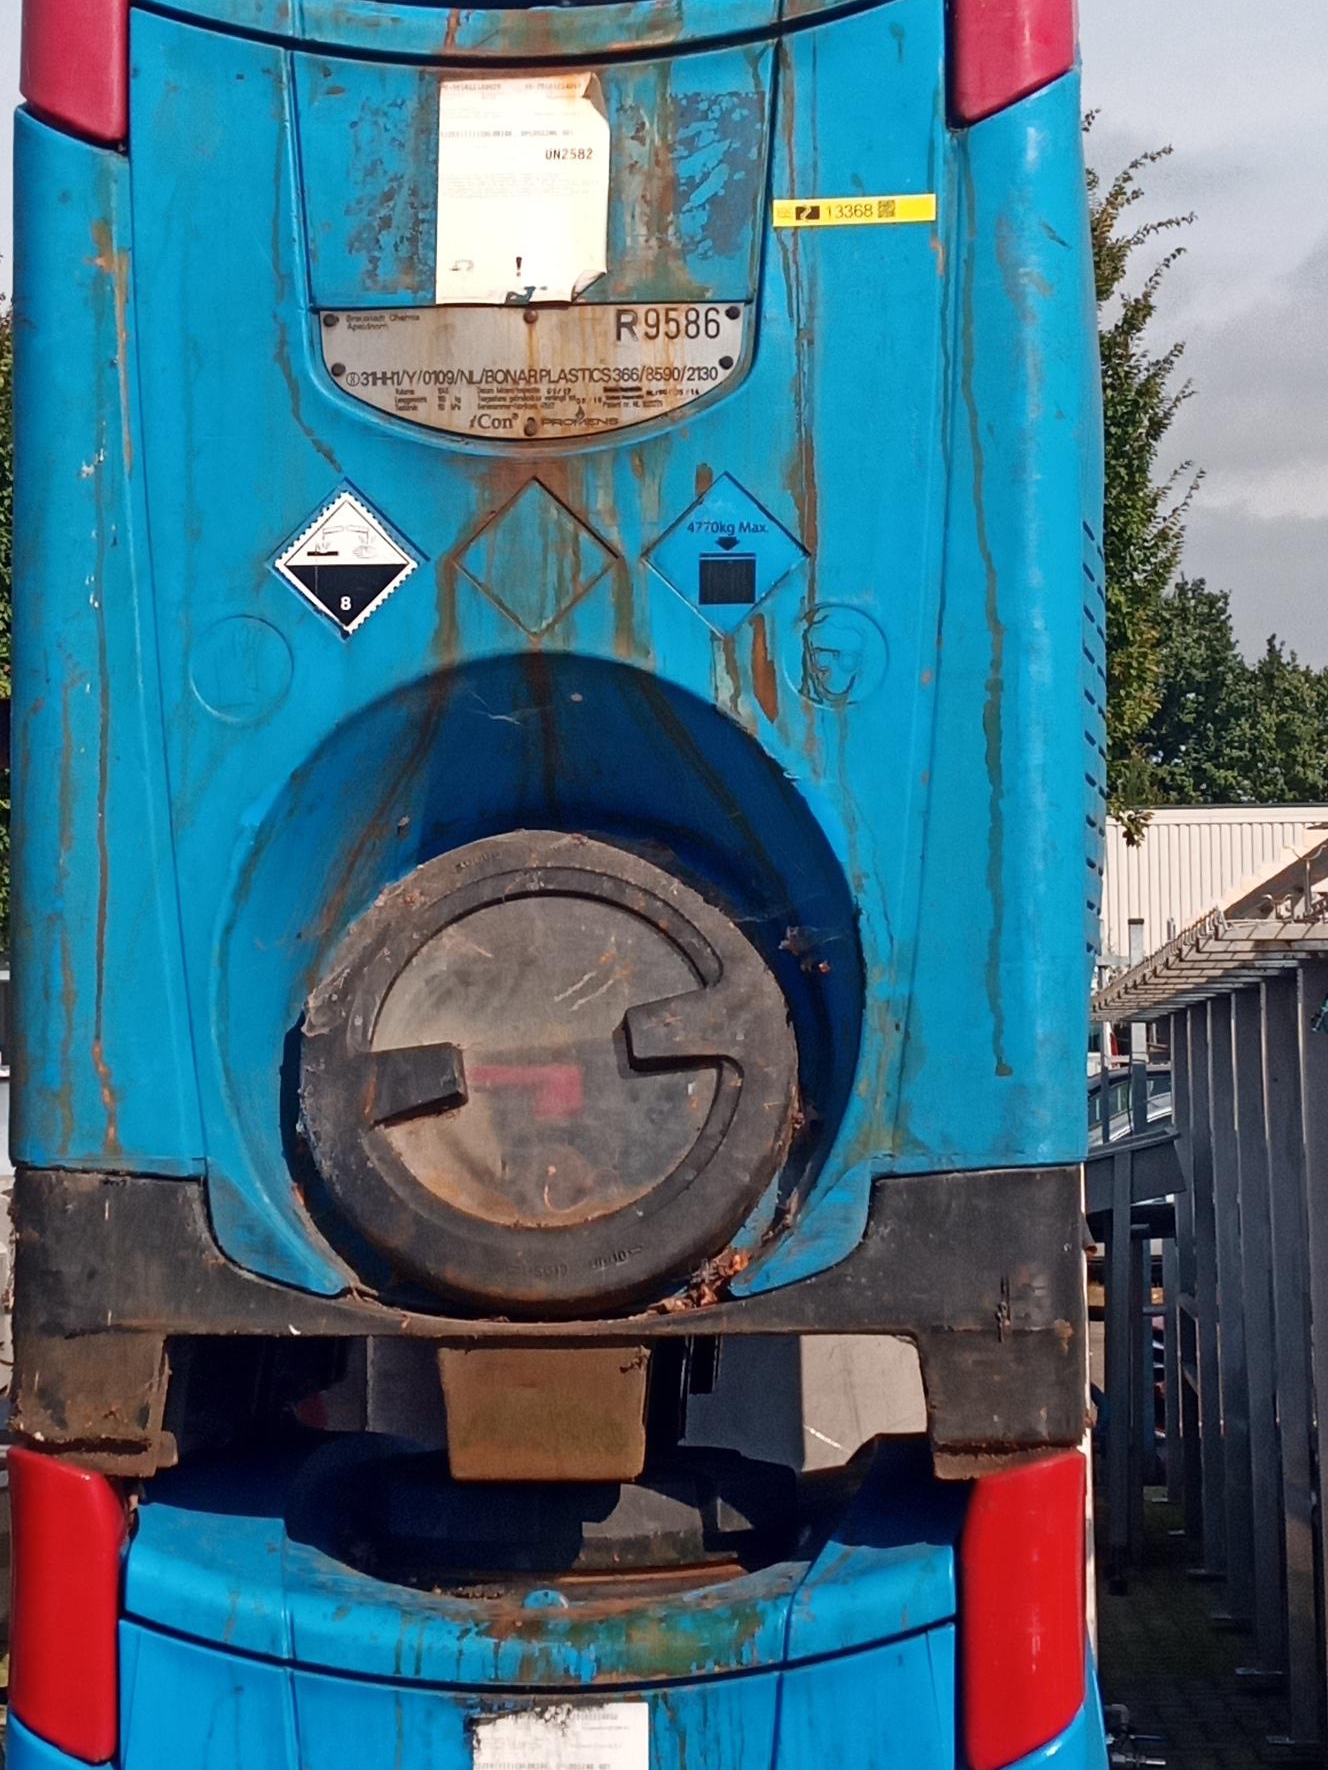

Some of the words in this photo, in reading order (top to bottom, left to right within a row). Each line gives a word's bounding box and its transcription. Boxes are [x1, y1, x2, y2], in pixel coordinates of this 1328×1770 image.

[545, 148, 593, 160] UN2582
[616, 307, 720, 341] R9586
[687, 521, 735, 536] 4770kg
[738, 521, 769, 533] Max.
[340, 596, 352, 611] 8
